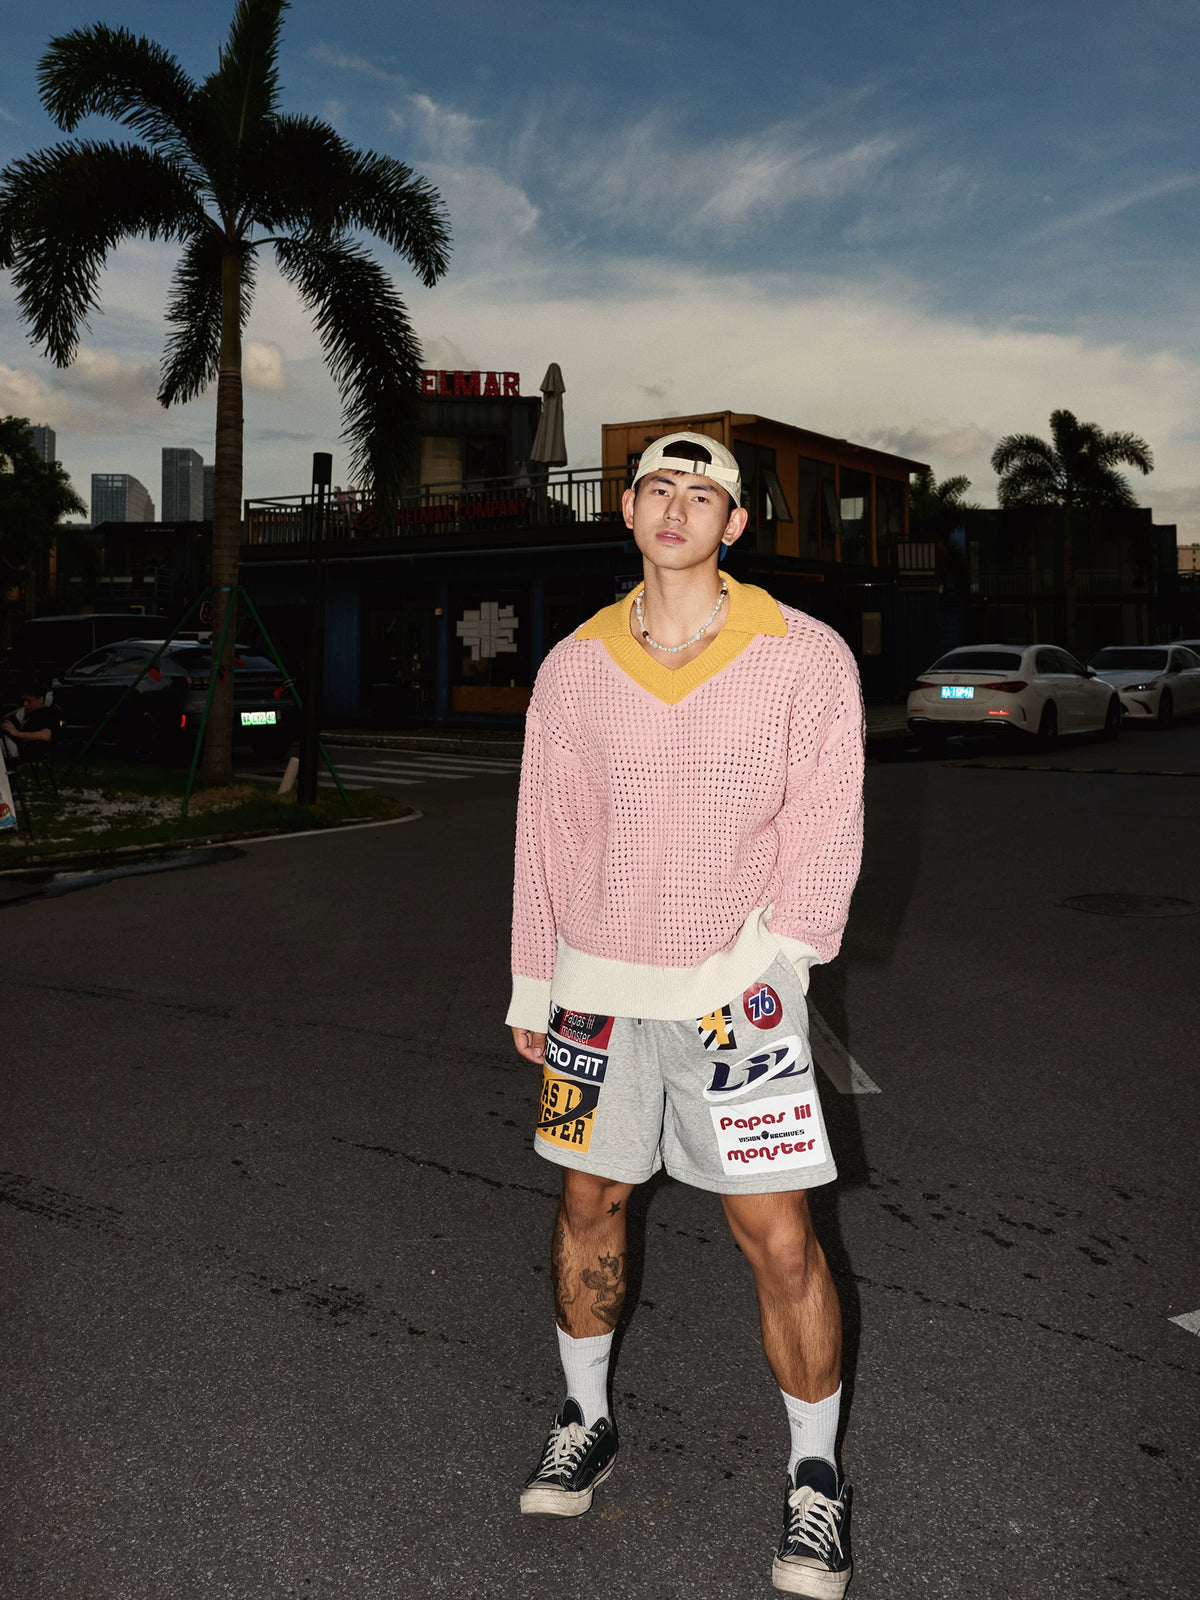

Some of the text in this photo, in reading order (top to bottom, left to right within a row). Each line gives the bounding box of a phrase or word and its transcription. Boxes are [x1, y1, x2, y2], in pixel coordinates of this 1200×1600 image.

[457, 498, 528, 521] COMPANY
[749, 987, 777, 1021] 76
[560, 1025, 591, 1045] monster
[573, 1054, 604, 1077] FIT
[719, 1103, 812, 1131] Papas lil
[738, 1128, 805, 1143] VISION ARCHIVES
[727, 1138, 816, 1163] monster
